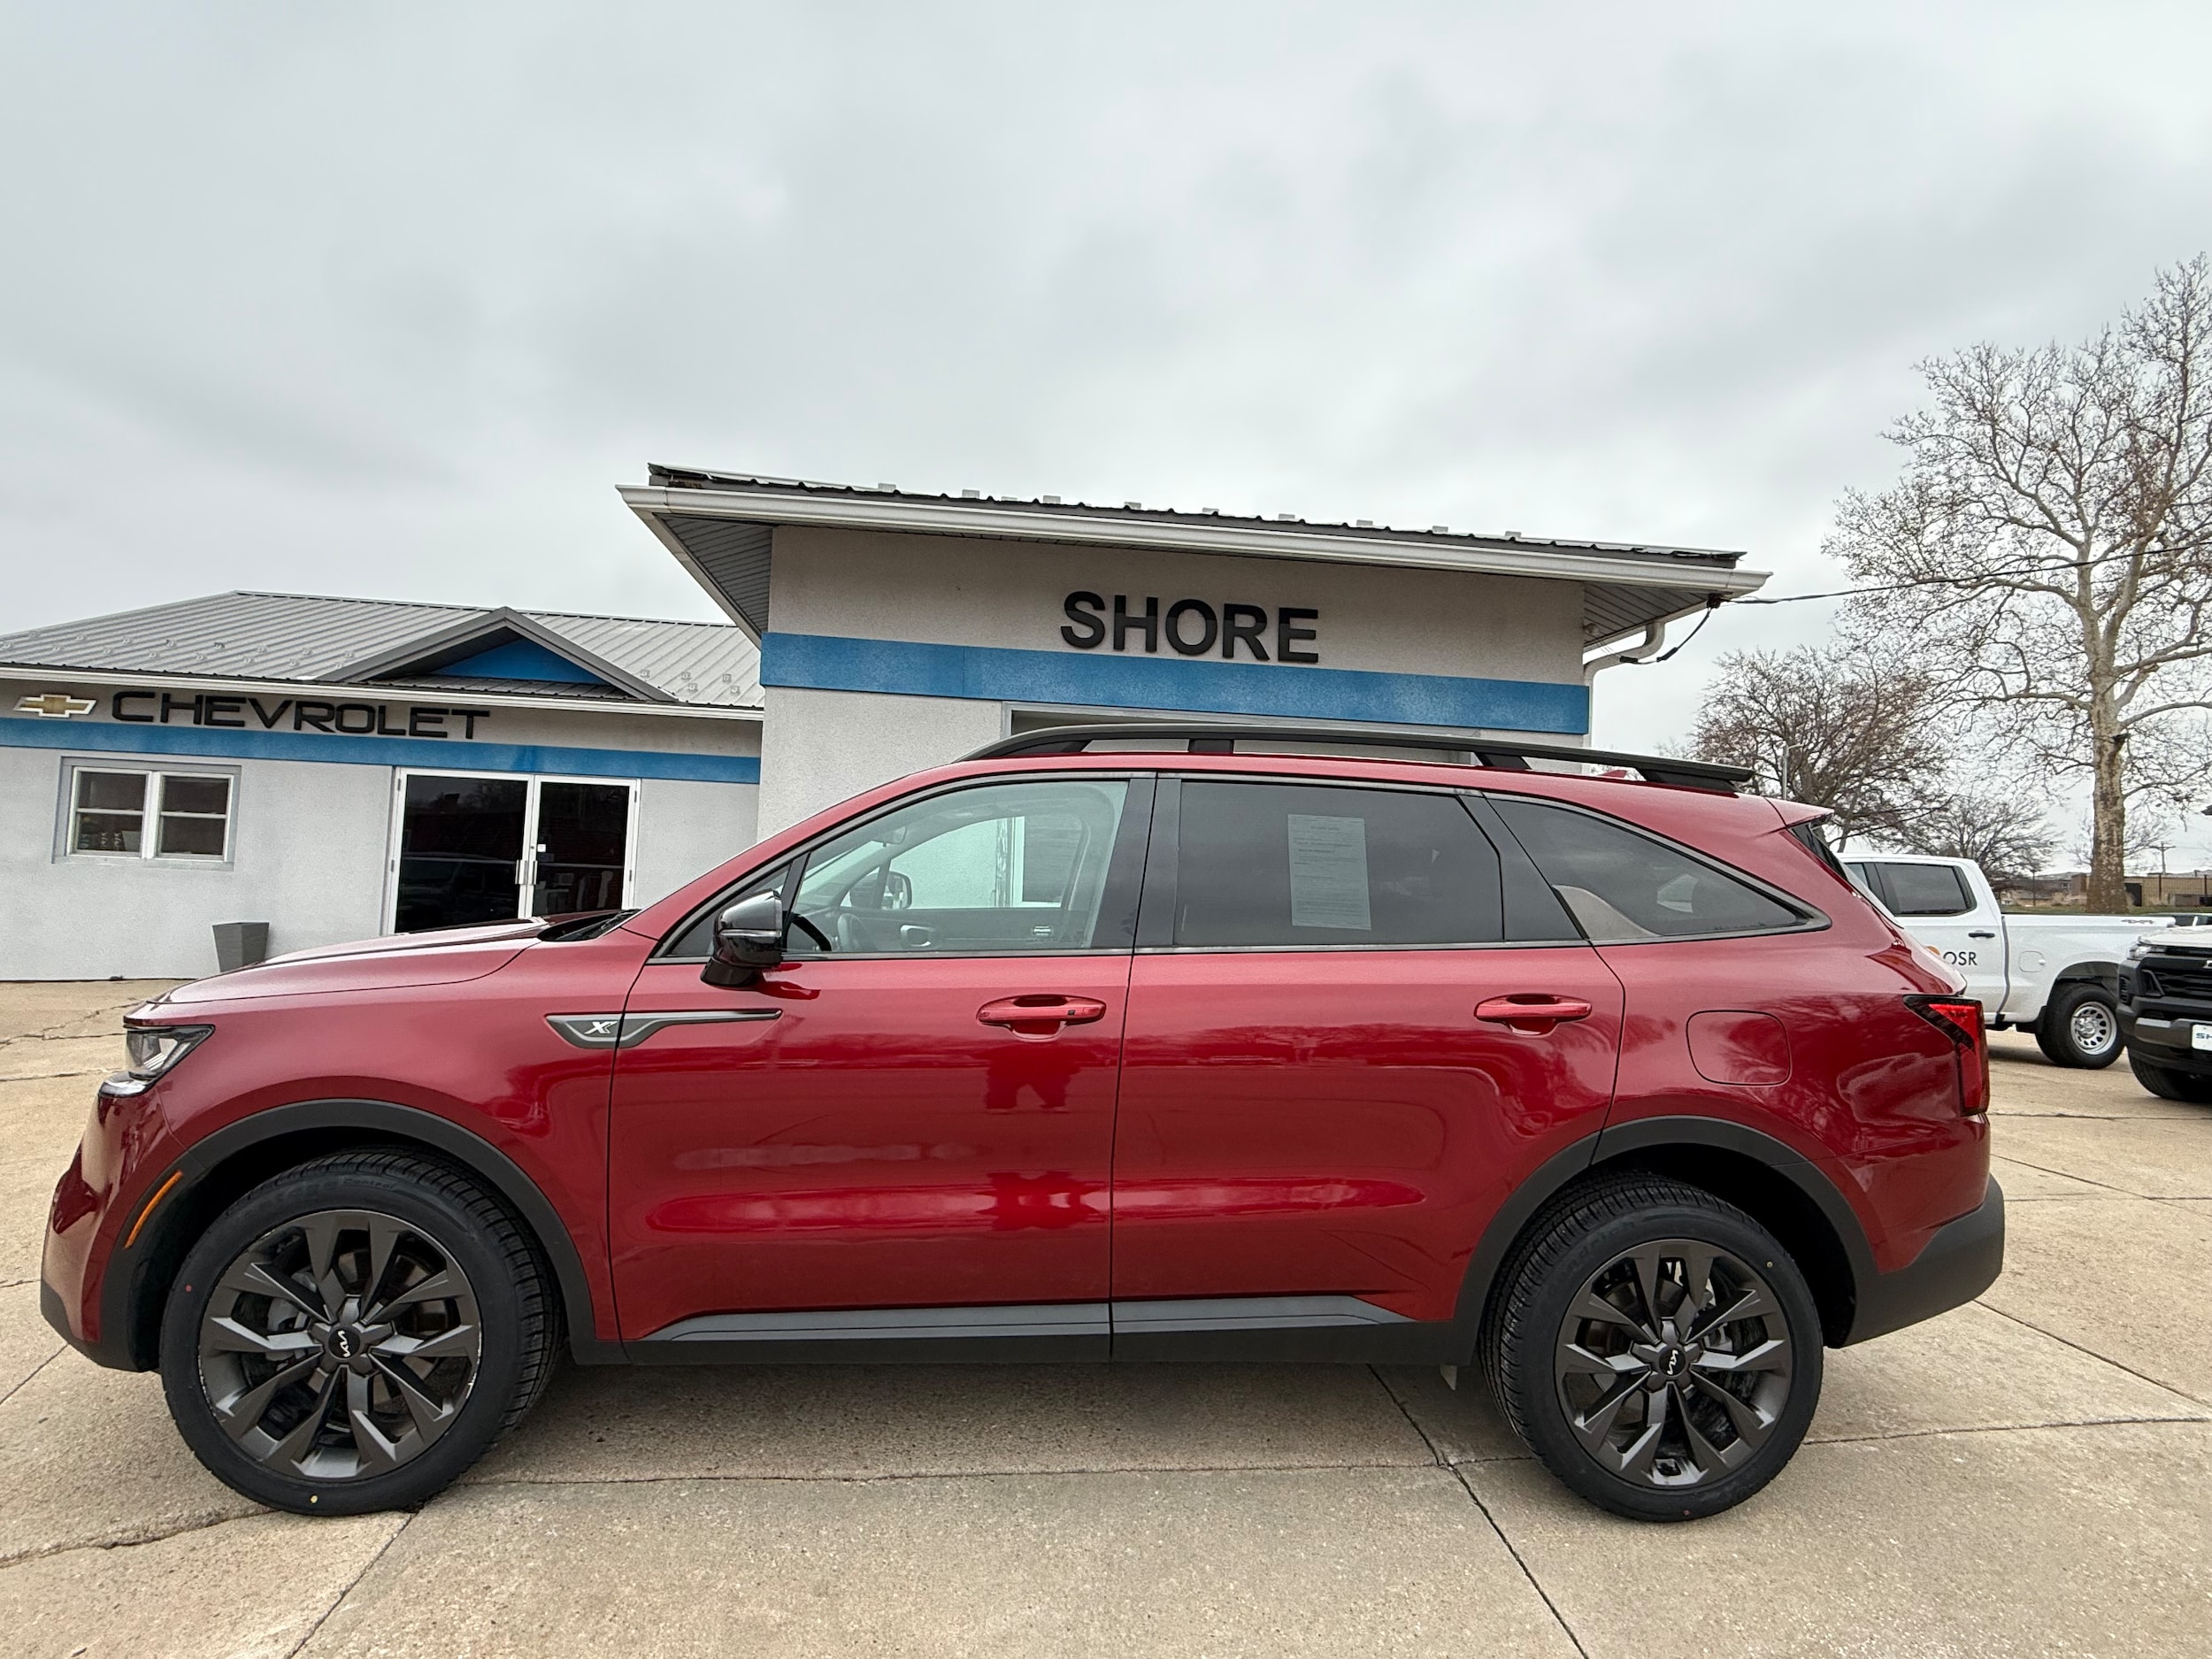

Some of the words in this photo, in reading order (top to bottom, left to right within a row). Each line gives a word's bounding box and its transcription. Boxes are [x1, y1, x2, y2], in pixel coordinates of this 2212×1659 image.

[1060, 590, 1319, 663] SHORE
[111, 690, 490, 740] CHEVROLET
[1943, 951, 1978, 965] OSR
